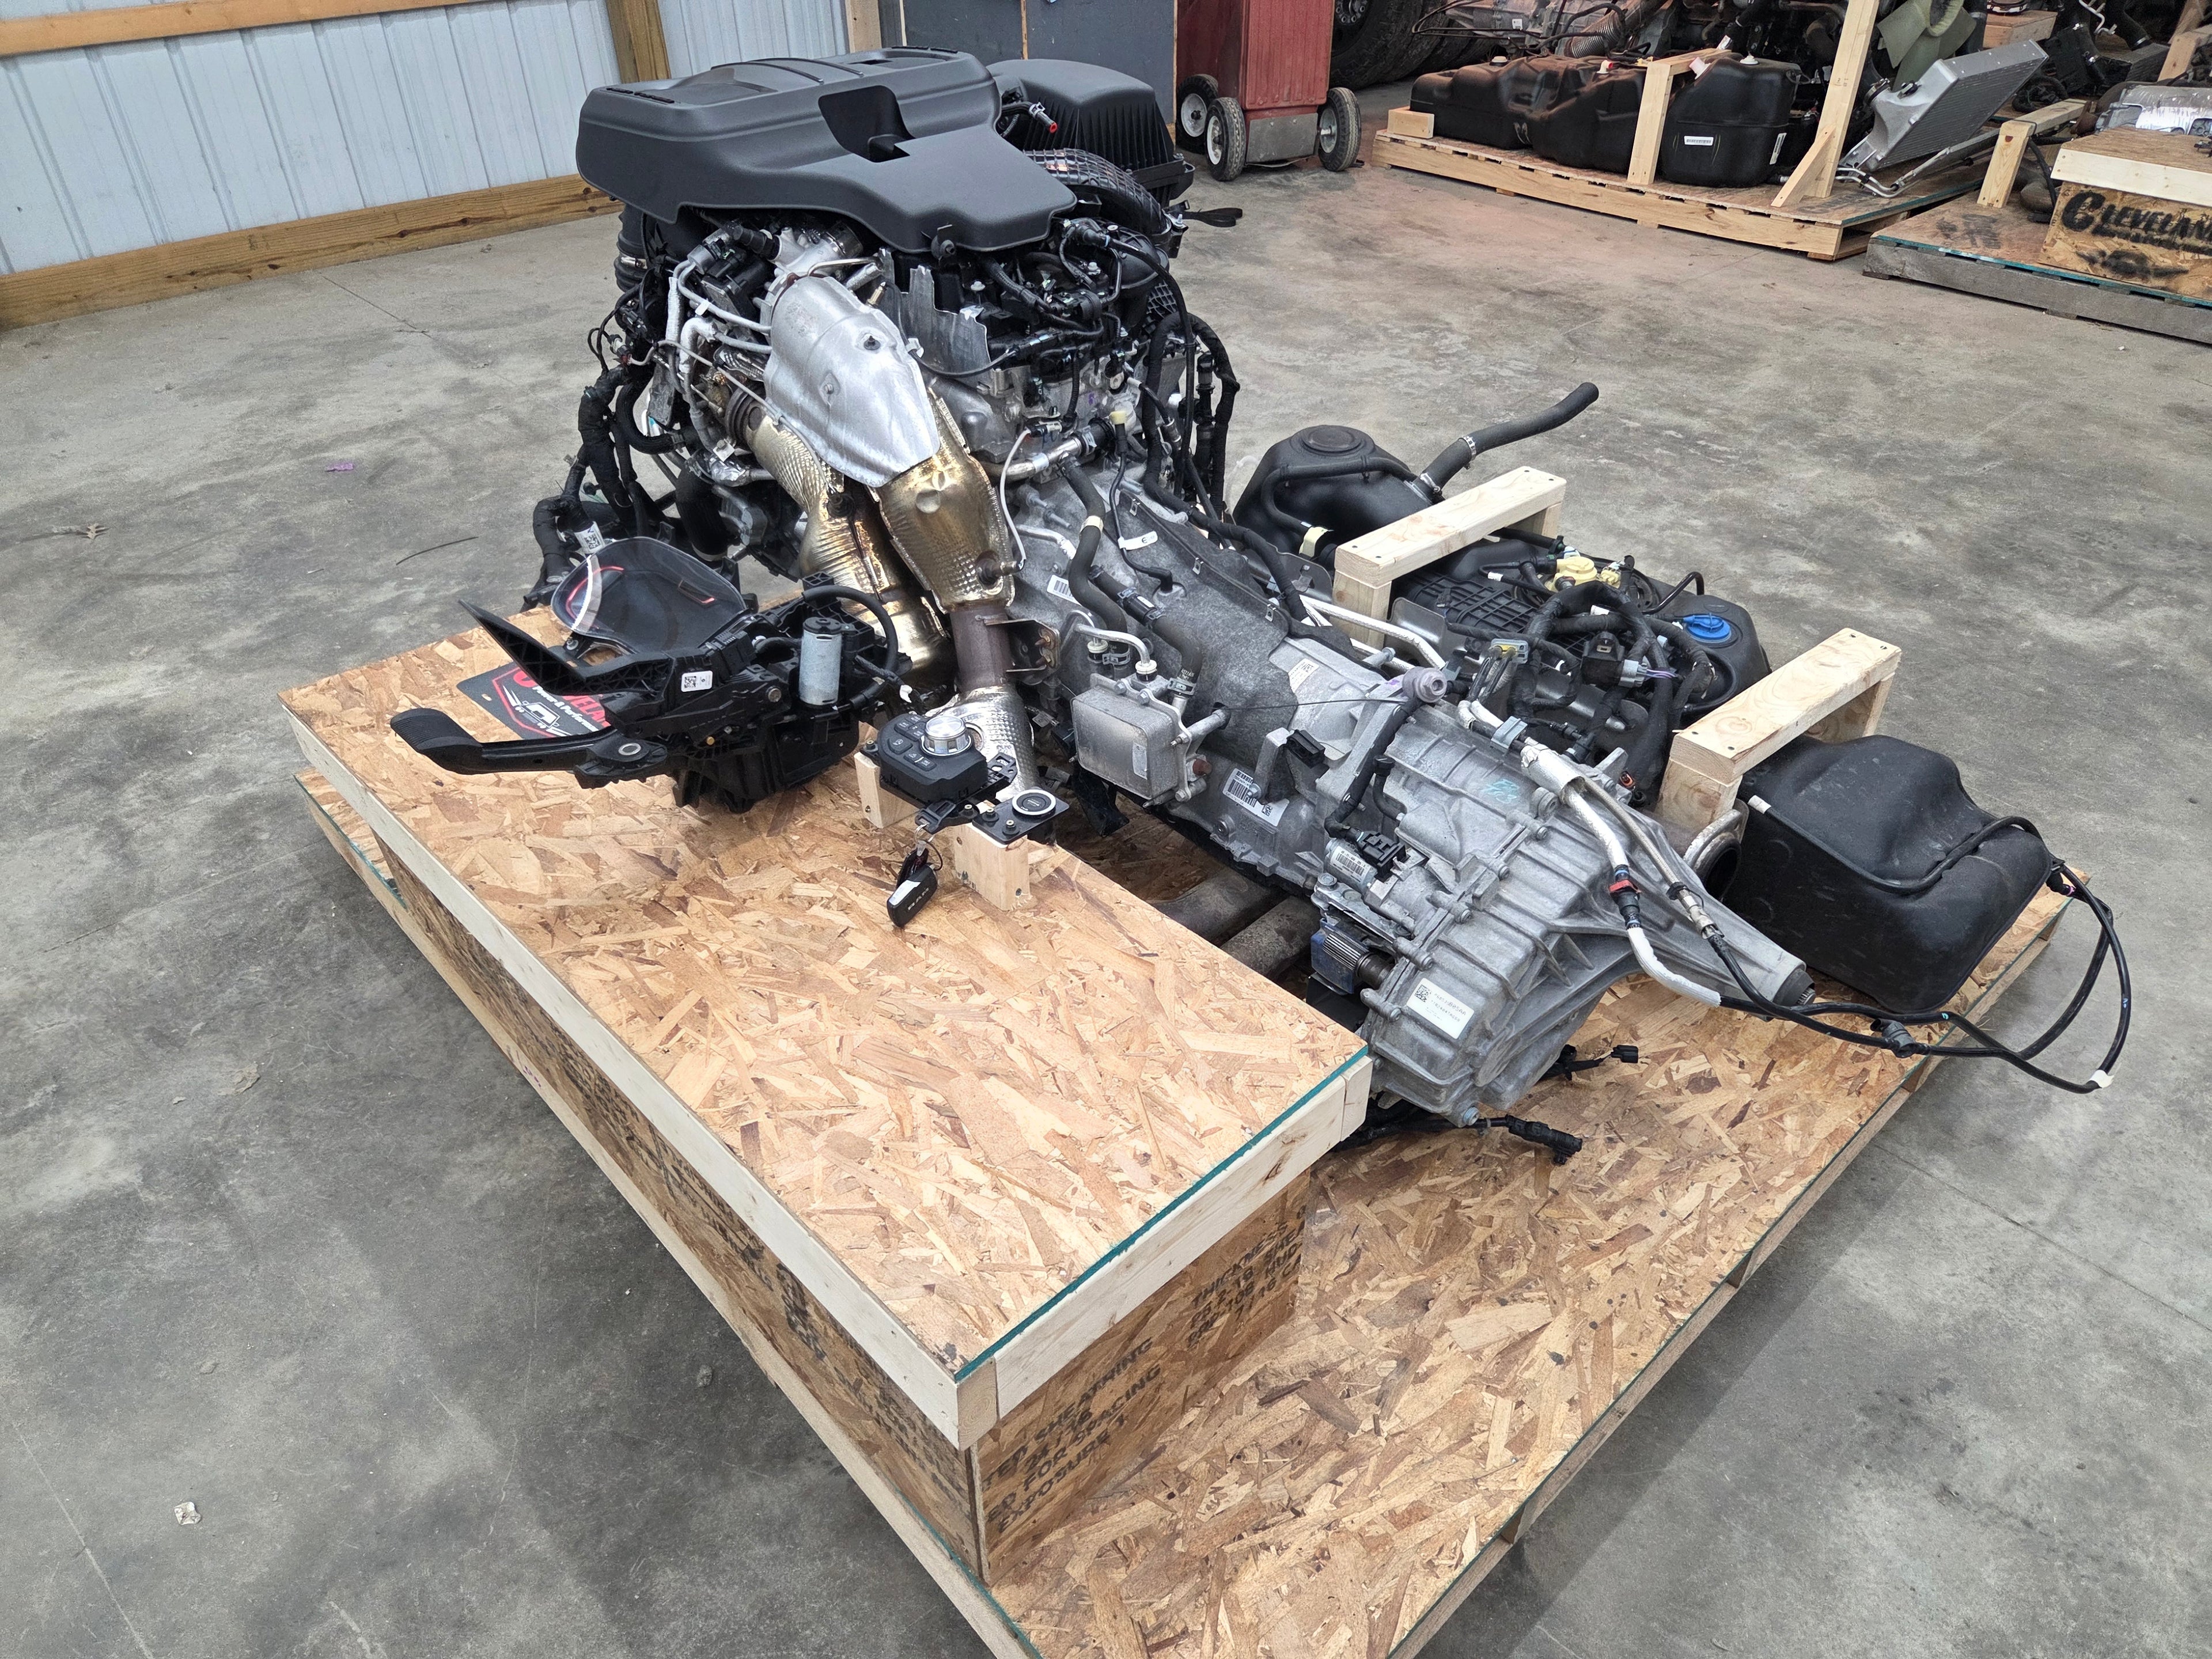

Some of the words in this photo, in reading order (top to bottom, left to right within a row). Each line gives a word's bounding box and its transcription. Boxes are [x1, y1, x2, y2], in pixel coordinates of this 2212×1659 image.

[908, 888, 929, 911] RAM
[1191, 1219, 1289, 1310] THICKNESS
[1022, 1444, 1067, 1493] FOR
[1070, 1363, 1161, 1450] SPACING
[1033, 1336, 1150, 1447] SHEATHING
[999, 1427, 1109, 1535] EXPOSURE
